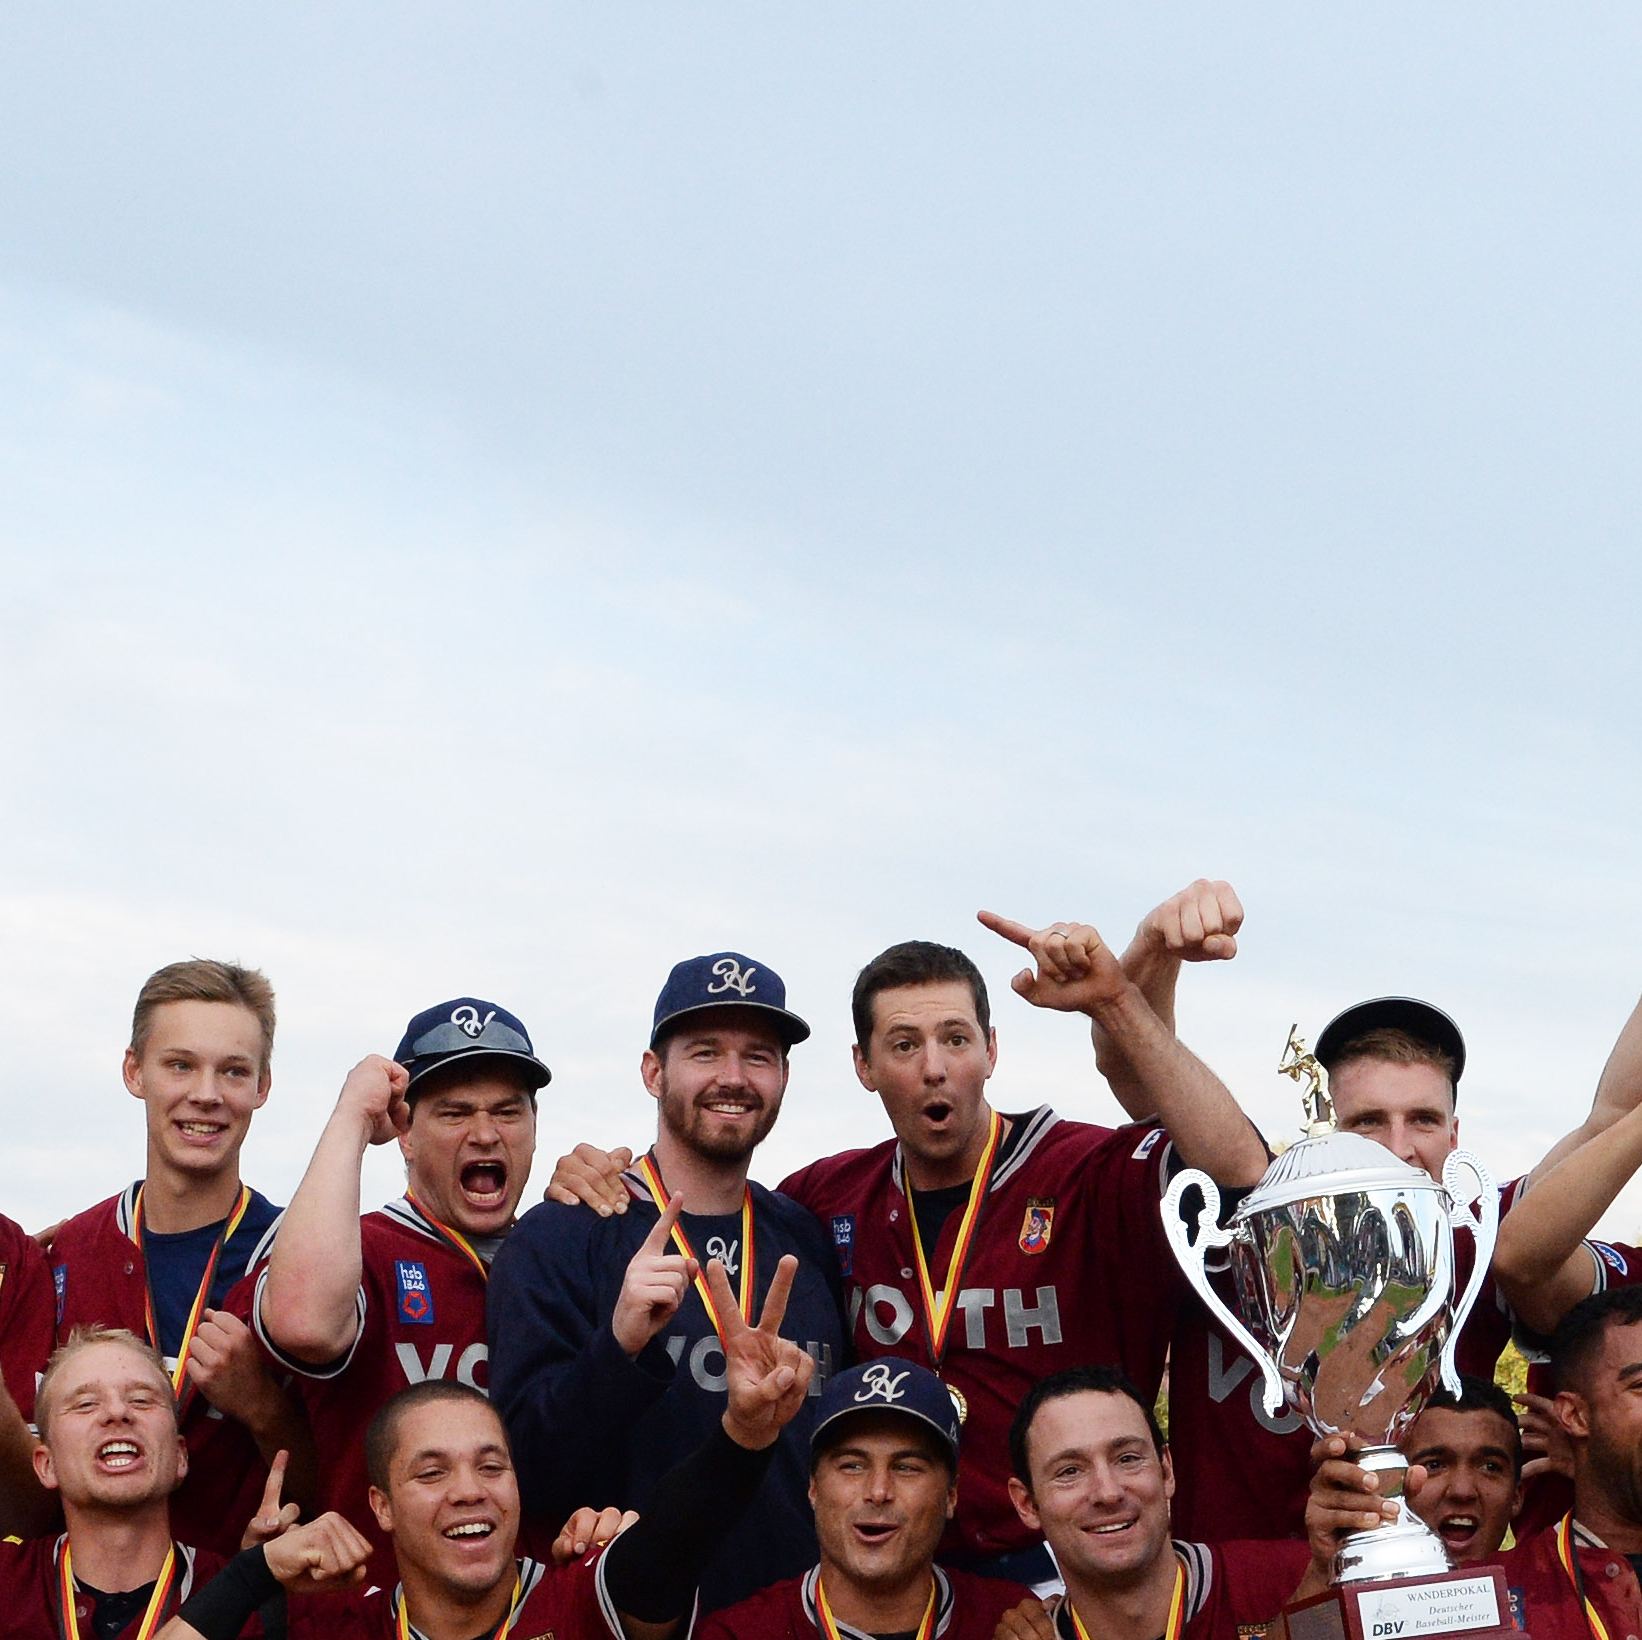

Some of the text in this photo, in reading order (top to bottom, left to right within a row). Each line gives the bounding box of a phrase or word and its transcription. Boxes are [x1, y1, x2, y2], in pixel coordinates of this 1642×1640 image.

[401, 1263, 424, 1282] hsb
[1407, 1585, 1490, 1602] WANDERPOKAL
[1429, 1603, 1473, 1616] Deutscher
[1373, 1621, 1404, 1636] DBV
[1415, 1614, 1490, 1630] Baseball-Meister
